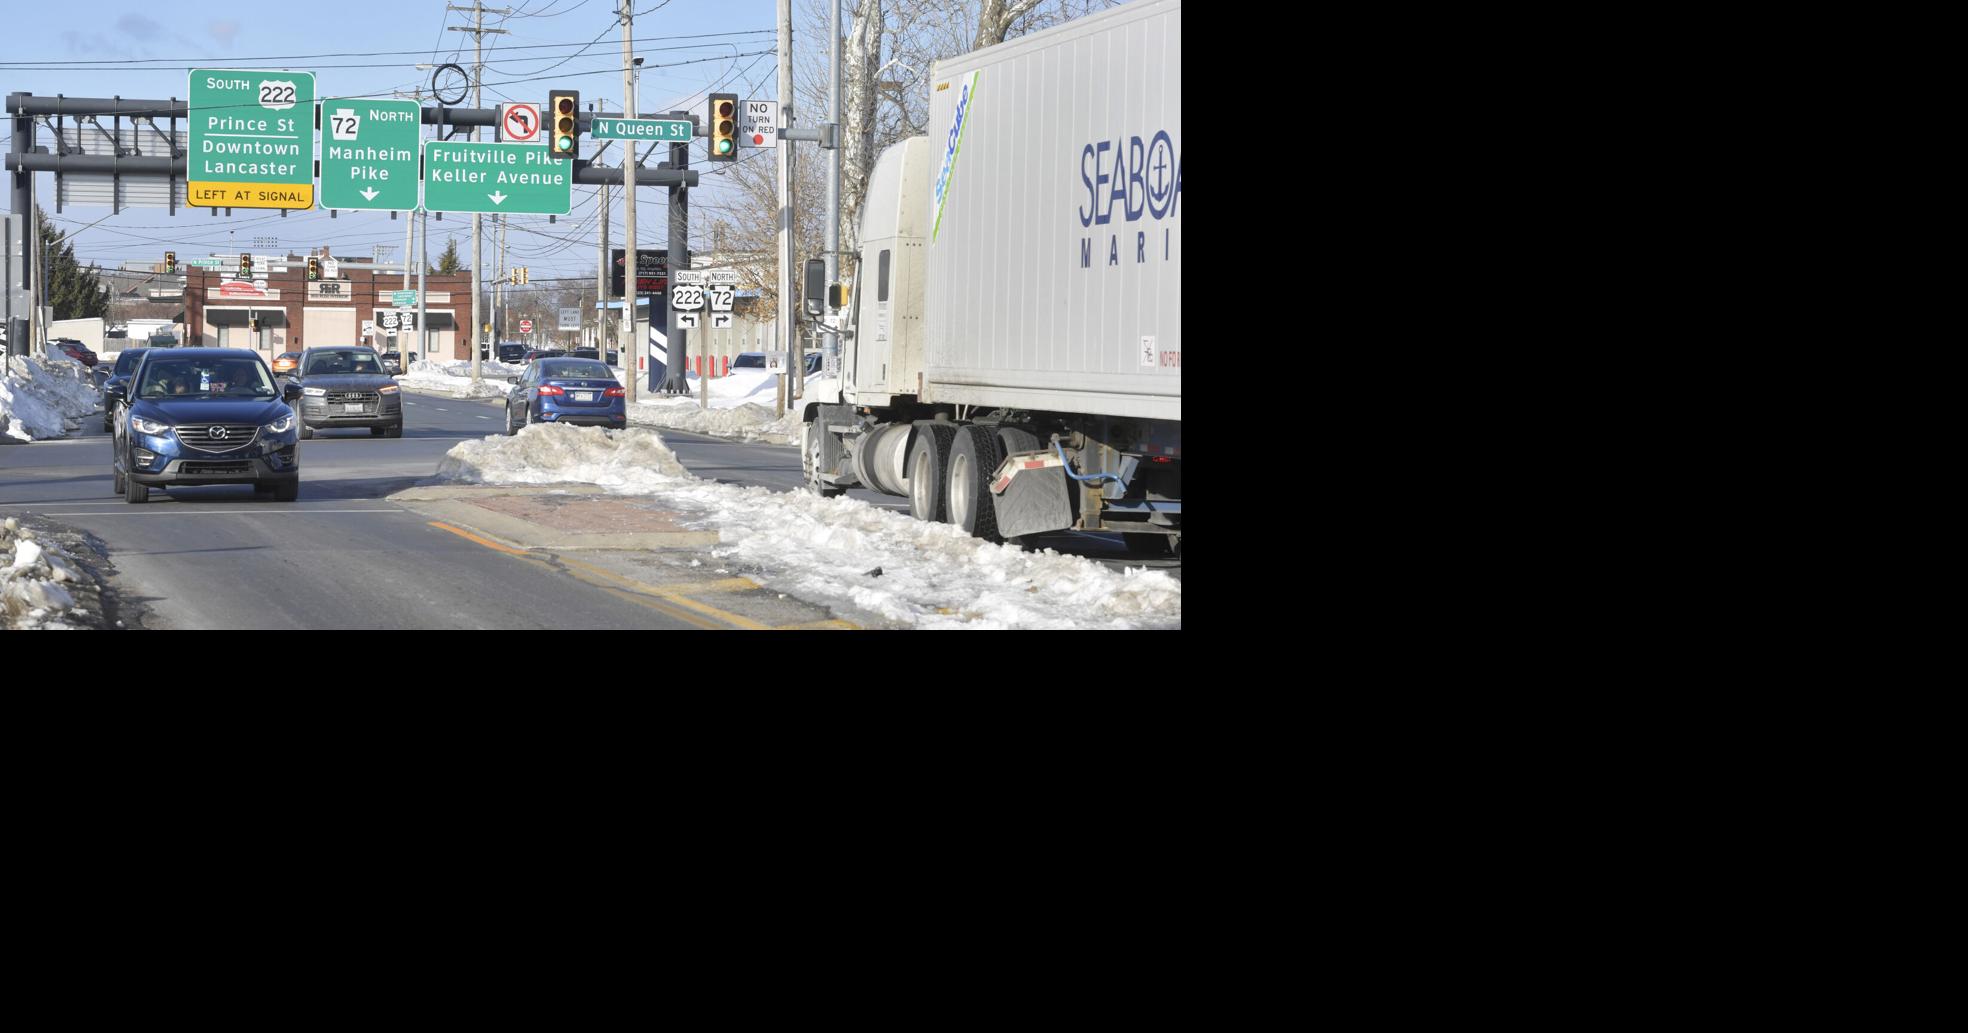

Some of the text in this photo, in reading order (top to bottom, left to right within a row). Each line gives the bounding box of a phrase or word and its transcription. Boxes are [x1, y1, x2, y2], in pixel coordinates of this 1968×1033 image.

[207, 77, 250, 90] SOUTH
[261, 86, 295, 103] 222
[369, 109, 414, 122] NORTH
[750, 103, 768, 113] NO
[208, 116, 295, 132] Prince St
[332, 117, 357, 134] 72
[748, 116, 770, 124] TURN
[599, 122, 685, 137] N Queen St
[742, 125, 775, 134] ON RED
[202, 140, 299, 156] Downtown
[329, 146, 411, 161] Manheim
[433, 149, 563, 166] Fruitville Pike
[205, 160, 297, 175] Lancaster
[351, 166, 389, 181] Pike
[432, 168, 563, 185] Keller Avenue
[196, 189, 304, 202] LEFT AT SIGNAL
[1080, 228, 1169, 268] MARI
[677, 272, 700, 281] SOUTH
[711, 272, 734, 281] NORTH
[675, 290, 701, 305] 222
[712, 291, 732, 306] 72
[385, 317, 397, 326] 222
